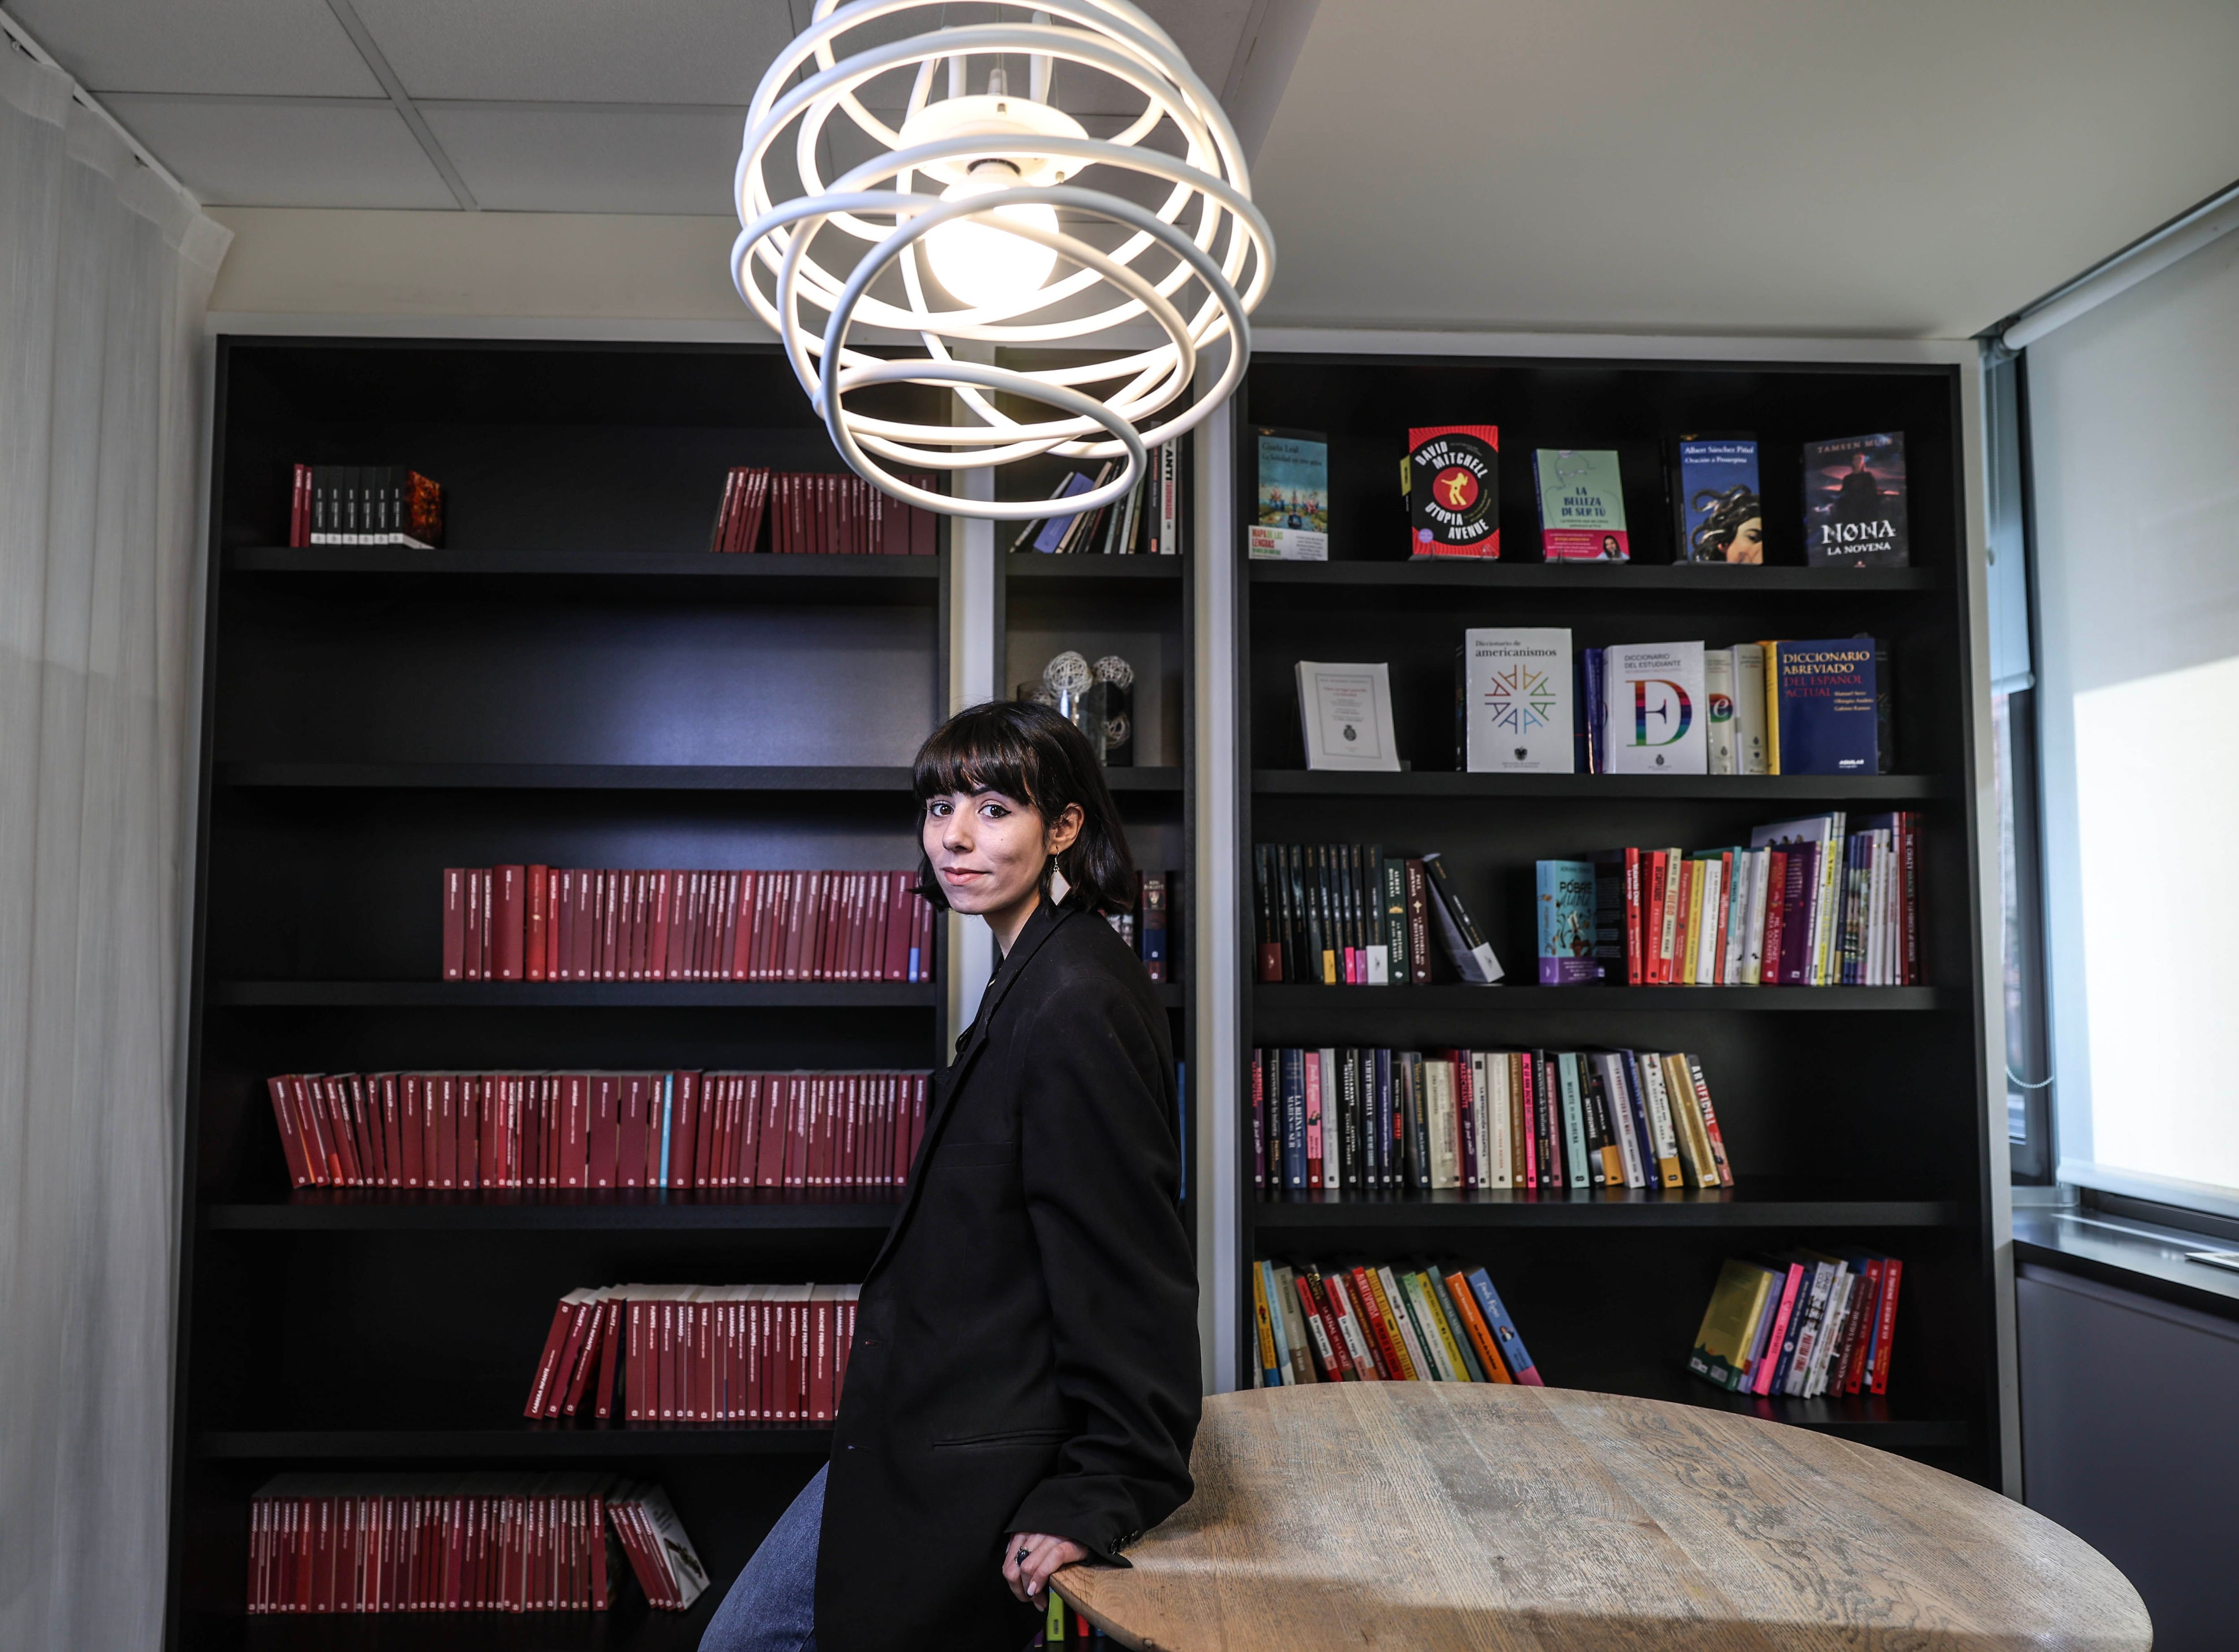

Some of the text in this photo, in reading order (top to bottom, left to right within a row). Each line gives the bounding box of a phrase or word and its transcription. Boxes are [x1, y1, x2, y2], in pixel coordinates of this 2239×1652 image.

[1684, 446, 1706, 454] Albert
[1708, 445, 1735, 454] Sánchez
[1817, 438, 1892, 453] TAMSYN MUIR
[1415, 441, 1448, 466] DAVID
[1166, 450, 1174, 481] ANTI
[1432, 452, 1488, 478] MITCHELL
[1564, 497, 1601, 506] BELLEZA
[1425, 502, 1463, 525] UTOPIA
[1562, 508, 1571, 516] DE
[1576, 508, 1591, 516] SER
[1448, 519, 1489, 539] AVENUE
[1252, 539, 1274, 548] LENGUAS
[1827, 542, 1892, 556] LA NOVENA
[1476, 647, 1557, 657] americanismos
[1783, 651, 1870, 664] DICCIONARIO
[1783, 663, 1854, 675] ABREVIADO
[1784, 676, 1806, 687] DEL
[1786, 687, 1831, 697] ACTUAL
[1666, 889, 1677, 916] FUEGO
[1460, 1063, 1468, 1108] MARCHANTE
[1691, 1065, 1716, 1127] ARTIFICIAL
[1585, 1098, 1597, 1139] INCERTIDUMBRE
[585, 1306, 602, 1351] CABRERA INFANTE
